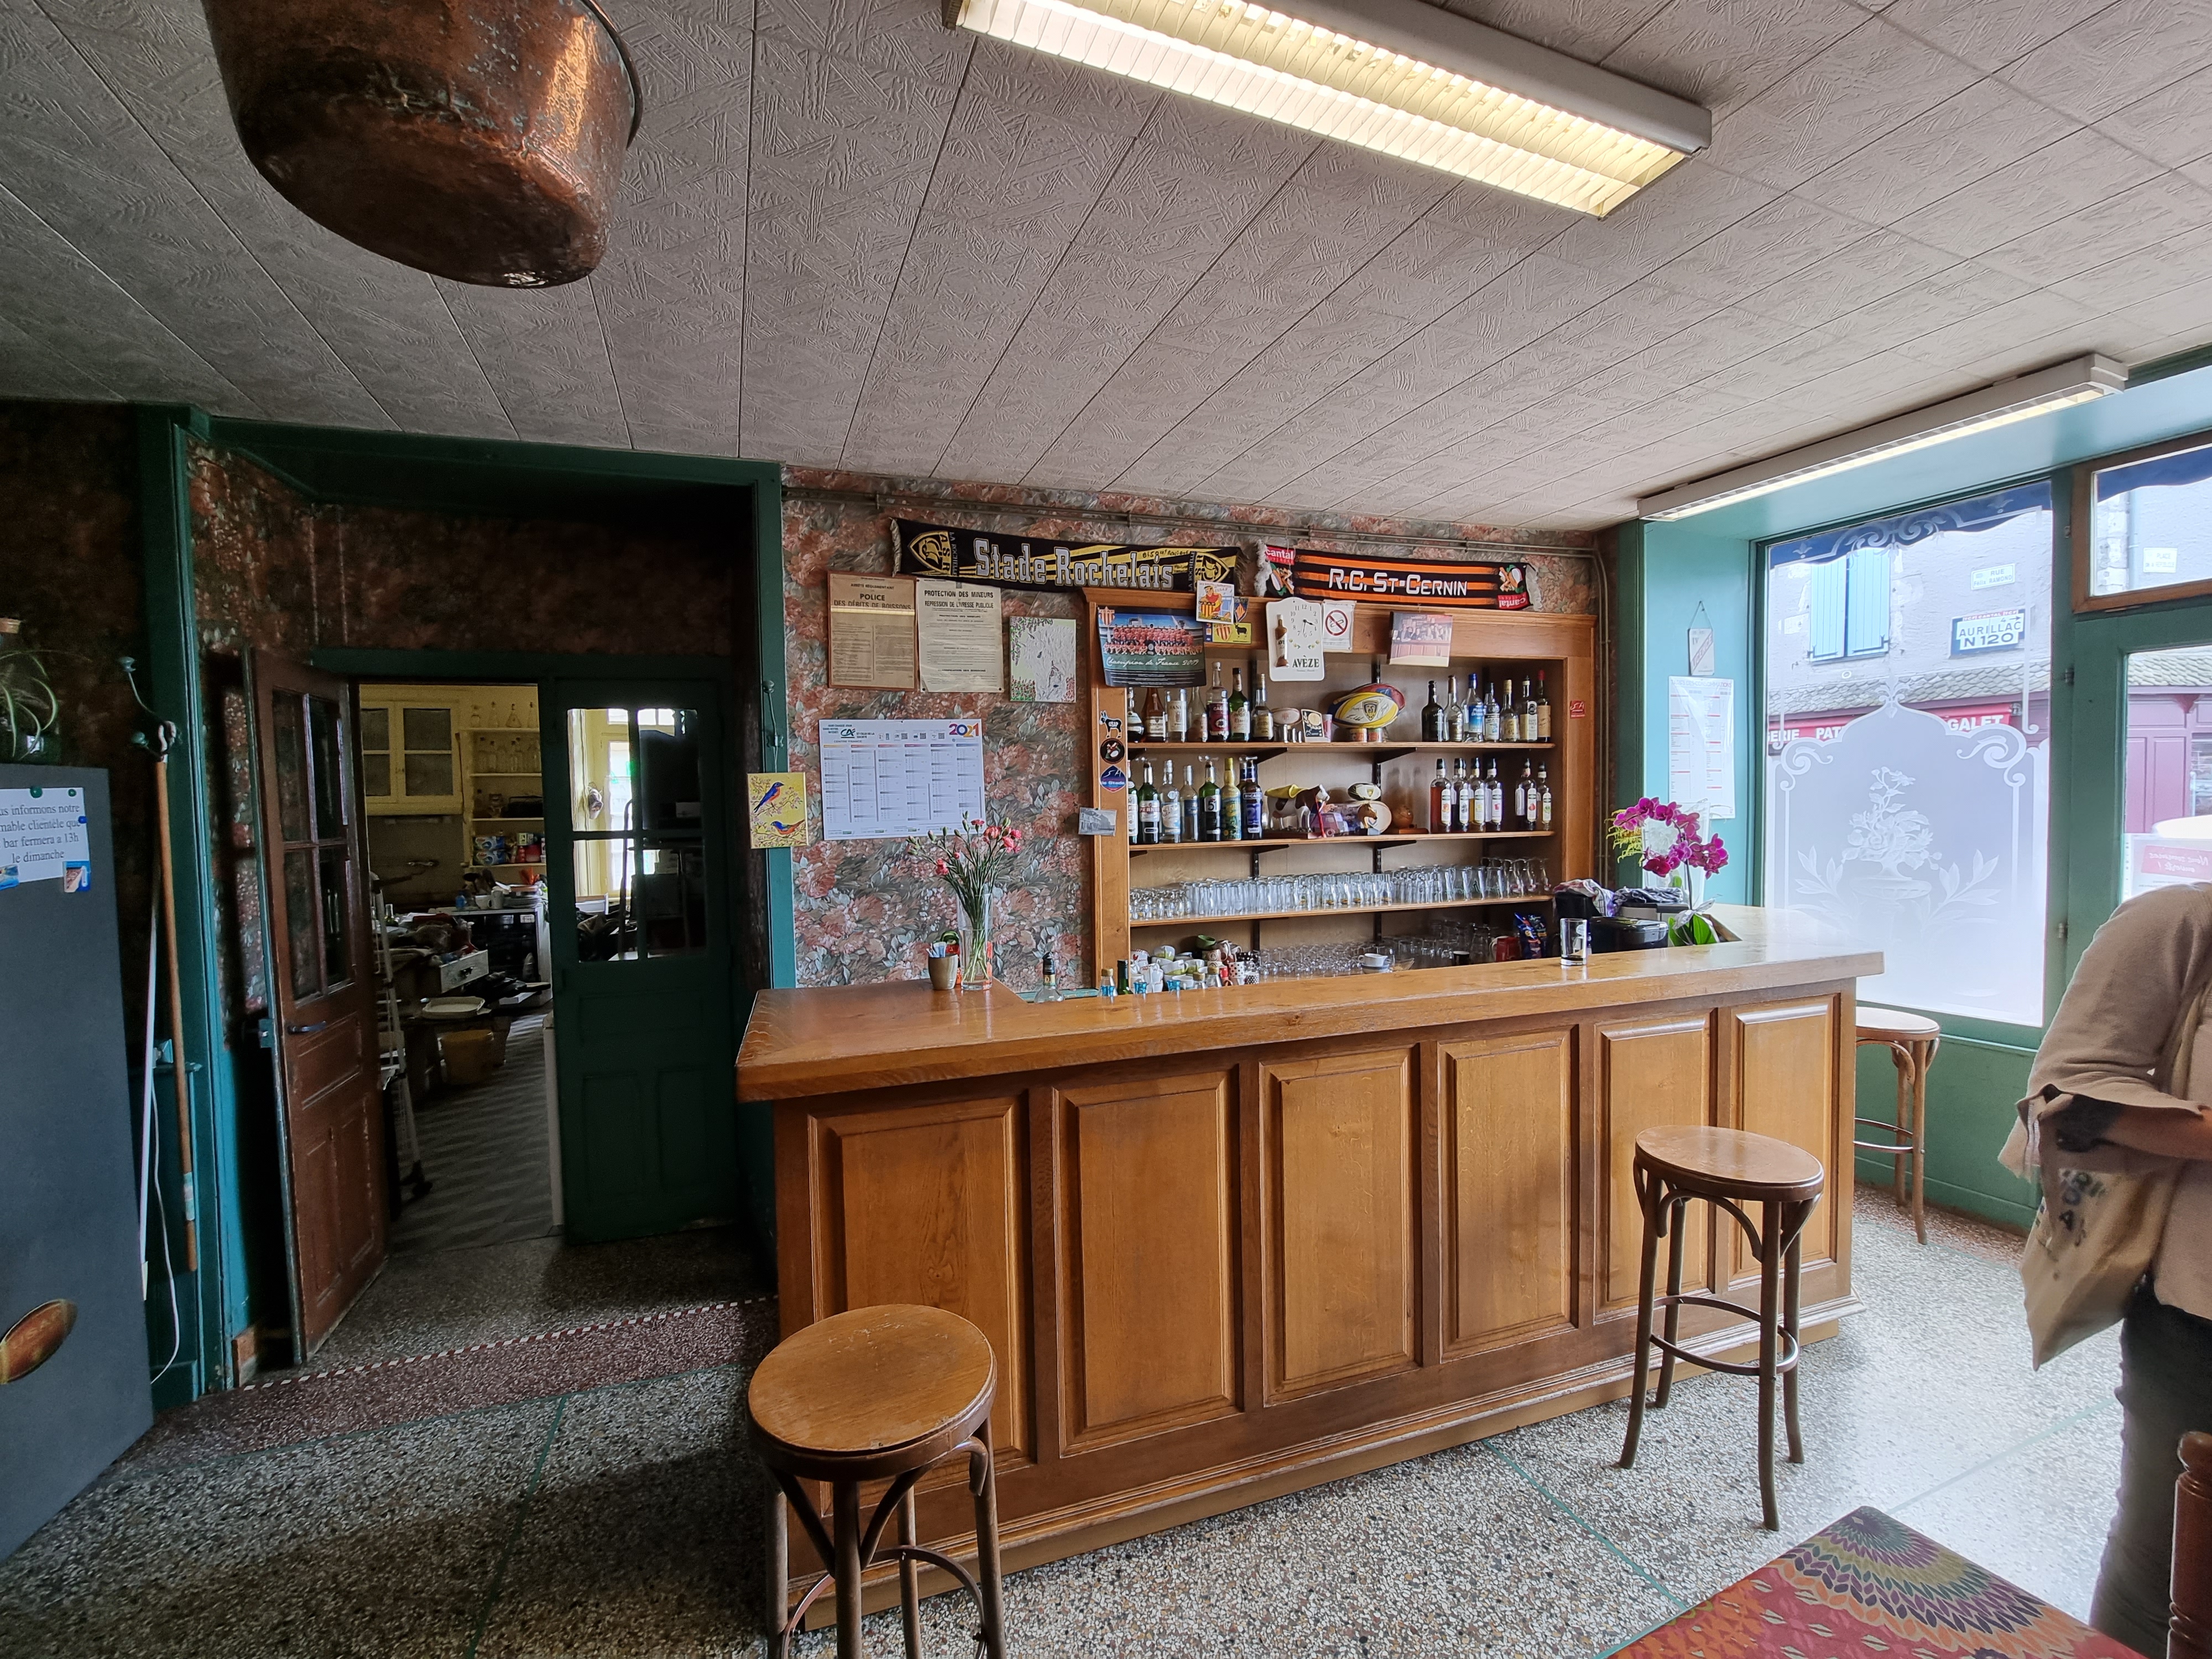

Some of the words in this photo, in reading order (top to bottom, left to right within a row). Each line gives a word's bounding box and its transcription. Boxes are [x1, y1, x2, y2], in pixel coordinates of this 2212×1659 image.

[1266, 549, 1293, 560] cantal
[974, 539, 1046, 583] Stade
[1055, 547, 1173, 588] Rochelais
[1328, 568, 1367, 591] R.C.
[1989, 575, 2012, 584] RAMOND
[1499, 597, 1526, 608] cantal
[1959, 622, 2021, 637] AURILLAC
[1964, 637, 1975, 648] N
[1980, 633, 2013, 645] 120
[1107, 656, 1144, 667] Champion
[1155, 658, 1180, 666] France
[1292, 655, 1319, 668] AVÈZE
[948, 723, 979, 738] 2021
[1768, 729, 1800, 742] ERIE
[11, 805, 56, 816] informons
[1208, 800, 1217, 811] 51
[28, 817, 64, 830] clientèle
[66, 820, 81, 830] que
[3, 838, 18, 848] bar
[21, 836, 55, 847] fermera
[64, 832, 79, 843] 13h
[12, 853, 20, 864] le
[23, 849, 65, 863] dimanche
